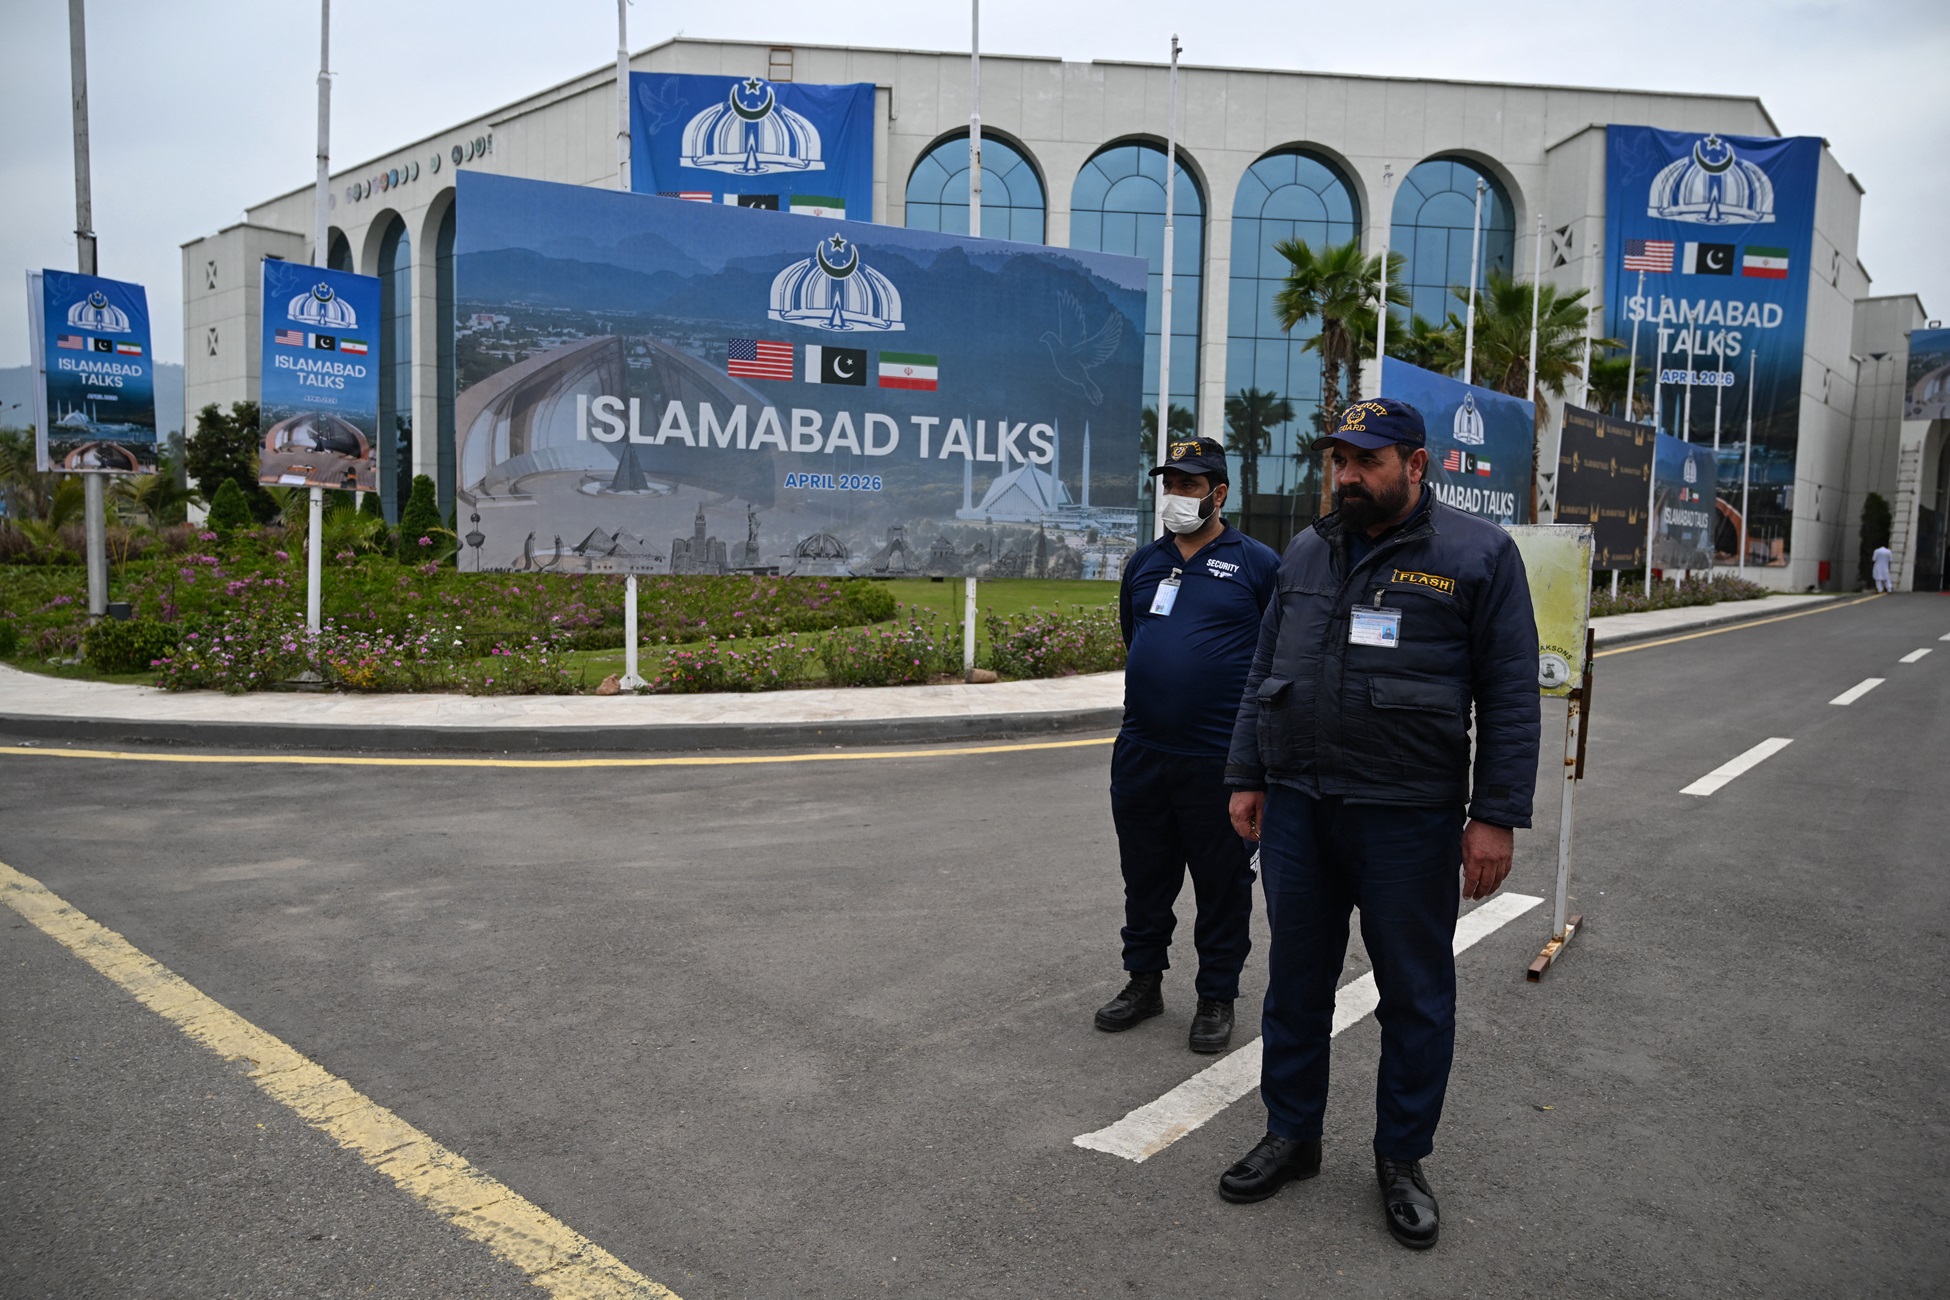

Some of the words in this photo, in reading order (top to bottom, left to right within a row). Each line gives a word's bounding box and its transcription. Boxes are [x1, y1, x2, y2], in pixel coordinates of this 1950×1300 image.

[1623, 295, 1783, 328] ISLAMABAD
[1657, 328, 1742, 357] TALKS
[58, 357, 142, 377] ISLAMABAD
[275, 354, 366, 378] ISLAMABAD
[79, 372, 123, 388] TALKS
[297, 372, 344, 389] TALKS
[1660, 369, 1698, 385] APRL
[576, 394, 900, 457] ISLAMABAD
[910, 415, 1055, 465] TALKS
[784, 472, 835, 490] APRIL
[838, 474, 883, 491] 2026
[1429, 481, 1481, 513] MABAD
[1483, 490, 1514, 515] TALKS
[1206, 558, 1240, 573] SECURITY
[1400, 573, 1450, 591] FLASH
[1540, 645, 1573, 660] AKSONS
